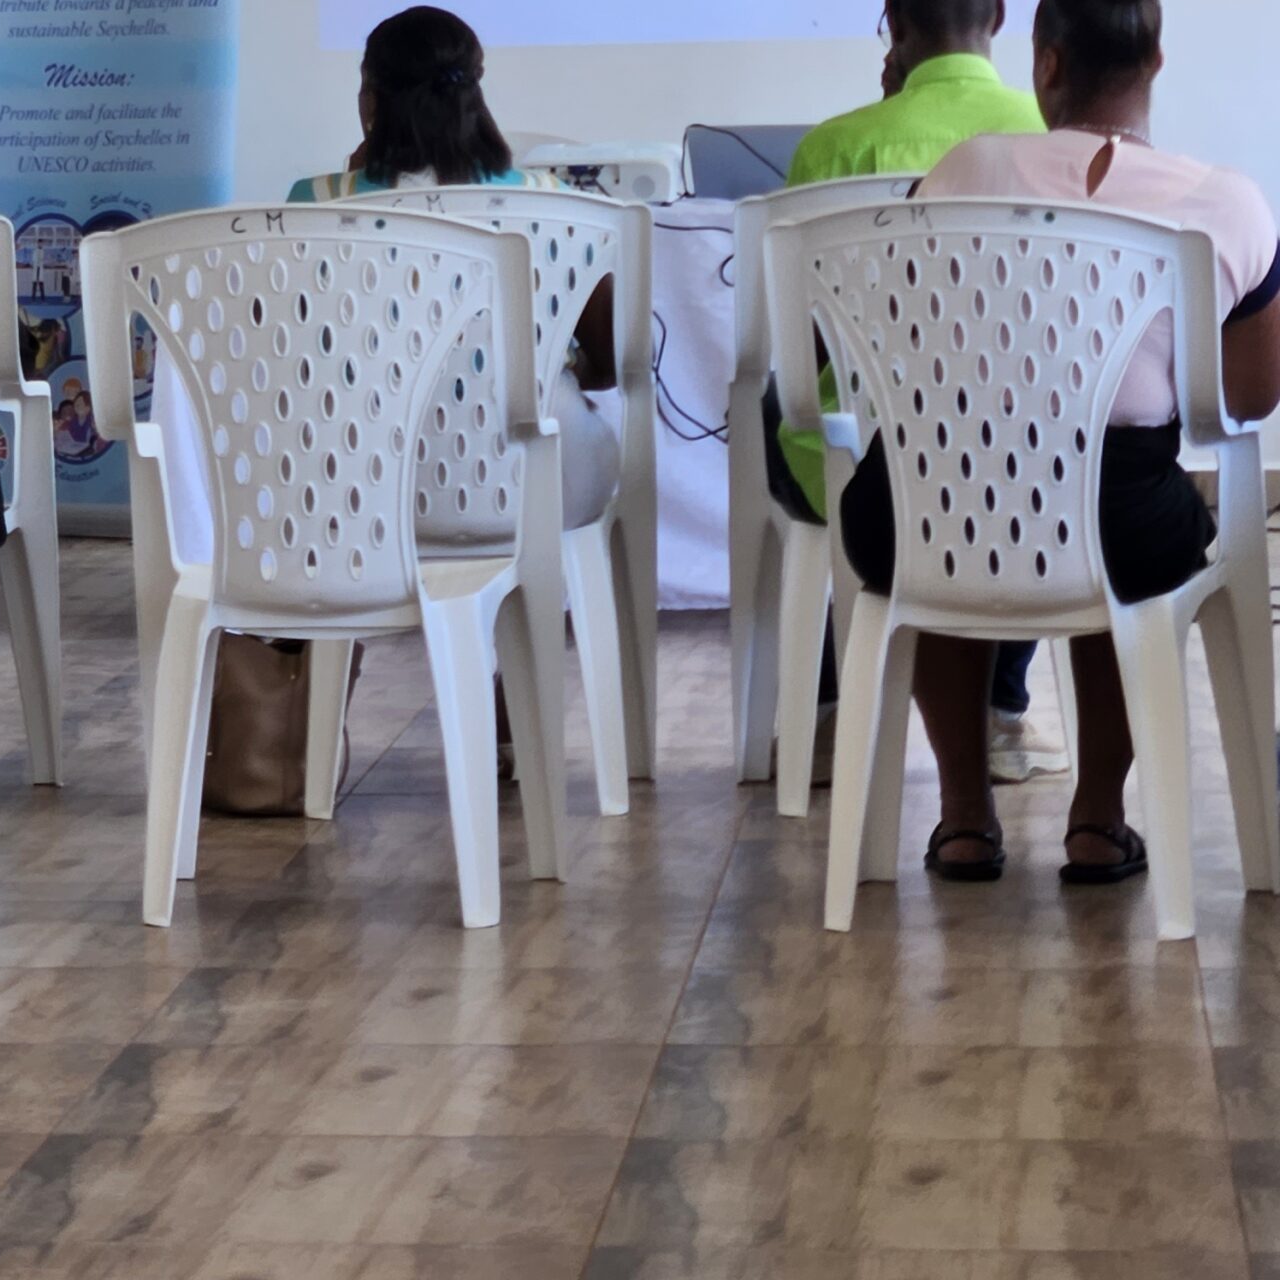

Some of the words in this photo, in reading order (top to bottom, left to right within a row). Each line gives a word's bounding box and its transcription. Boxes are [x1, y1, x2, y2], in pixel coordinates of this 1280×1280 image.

[115, 0, 124, 10] a
[8, 21, 91, 38] sustainable
[44, 63, 135, 88] Mission:
[65, 104, 94, 120] and
[95, 103, 157, 123] facilitate
[161, 102, 182, 119] the
[83, 130, 101, 150] of
[102, 130, 173, 151] Seychelles
[175, 130, 190, 144] in
[18, 156, 88, 173] UNESCO
